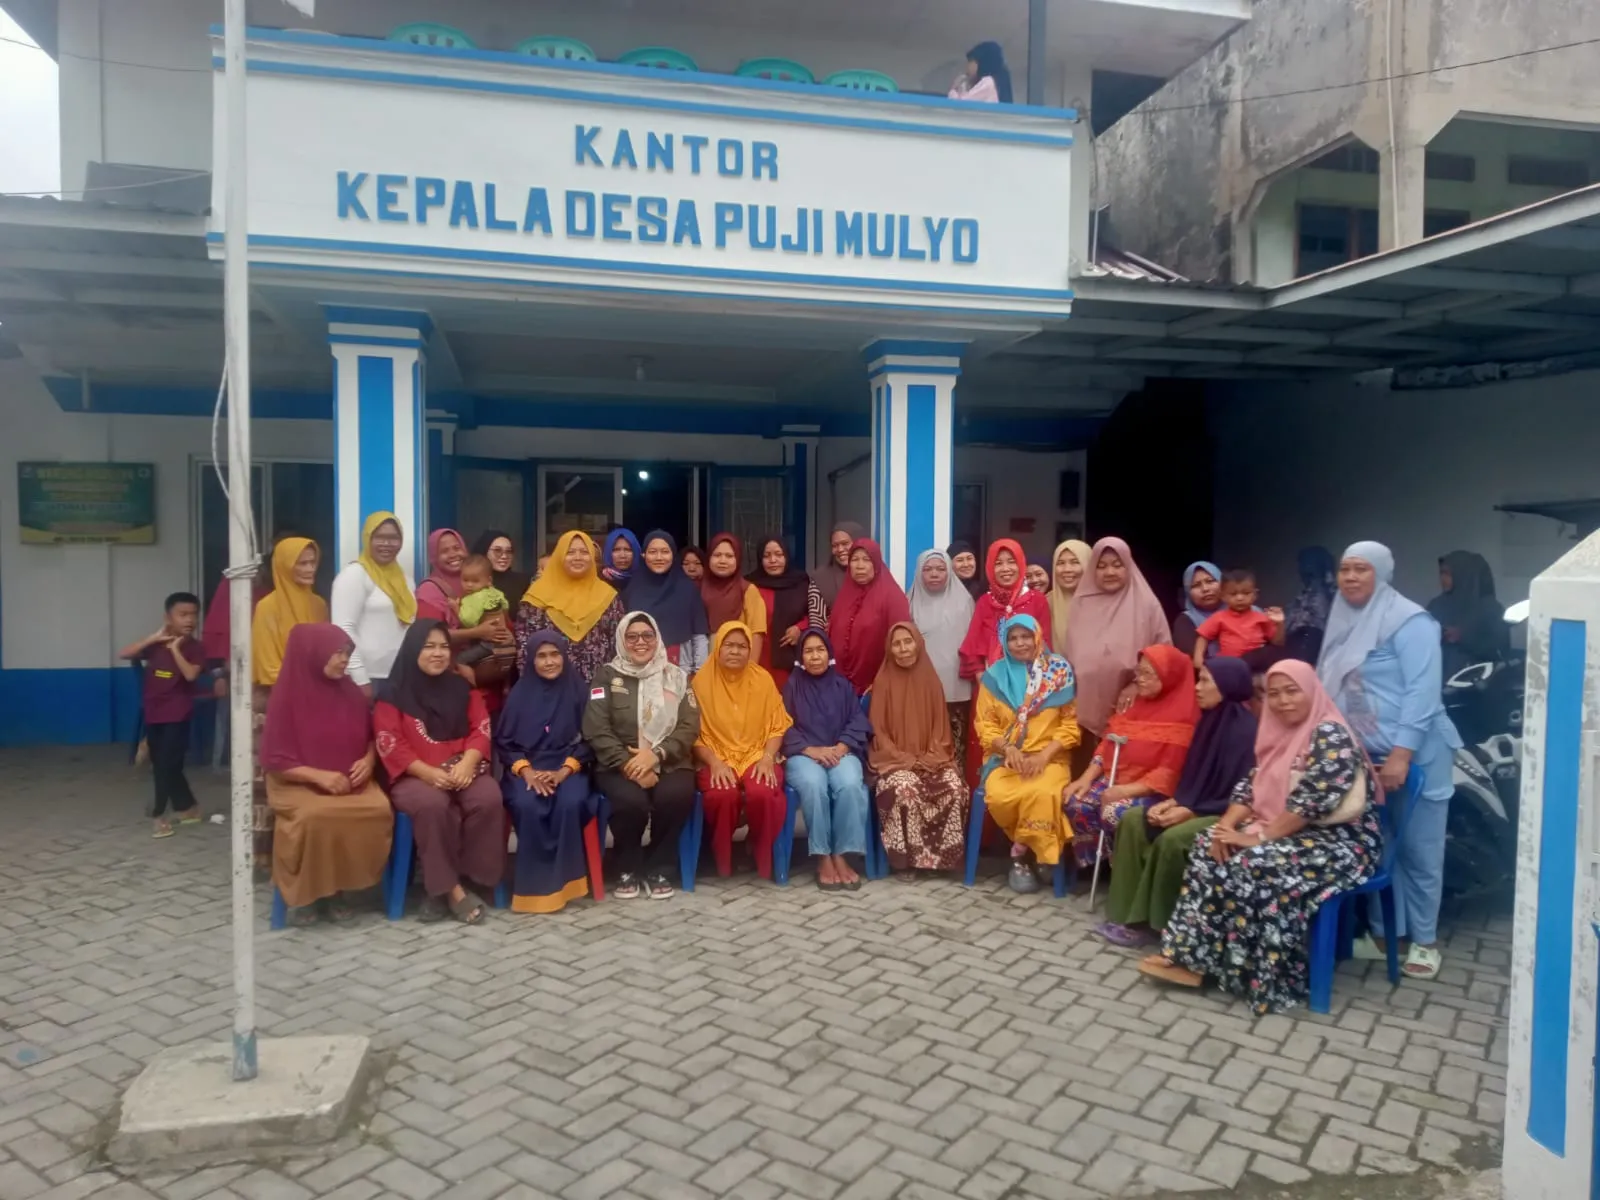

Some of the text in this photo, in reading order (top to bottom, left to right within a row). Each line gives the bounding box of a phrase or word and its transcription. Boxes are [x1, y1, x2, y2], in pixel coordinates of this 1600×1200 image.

[575, 125, 778, 180] KANTOR
[337, 172, 979, 263] KEPALA DESA PUJI MULYO
